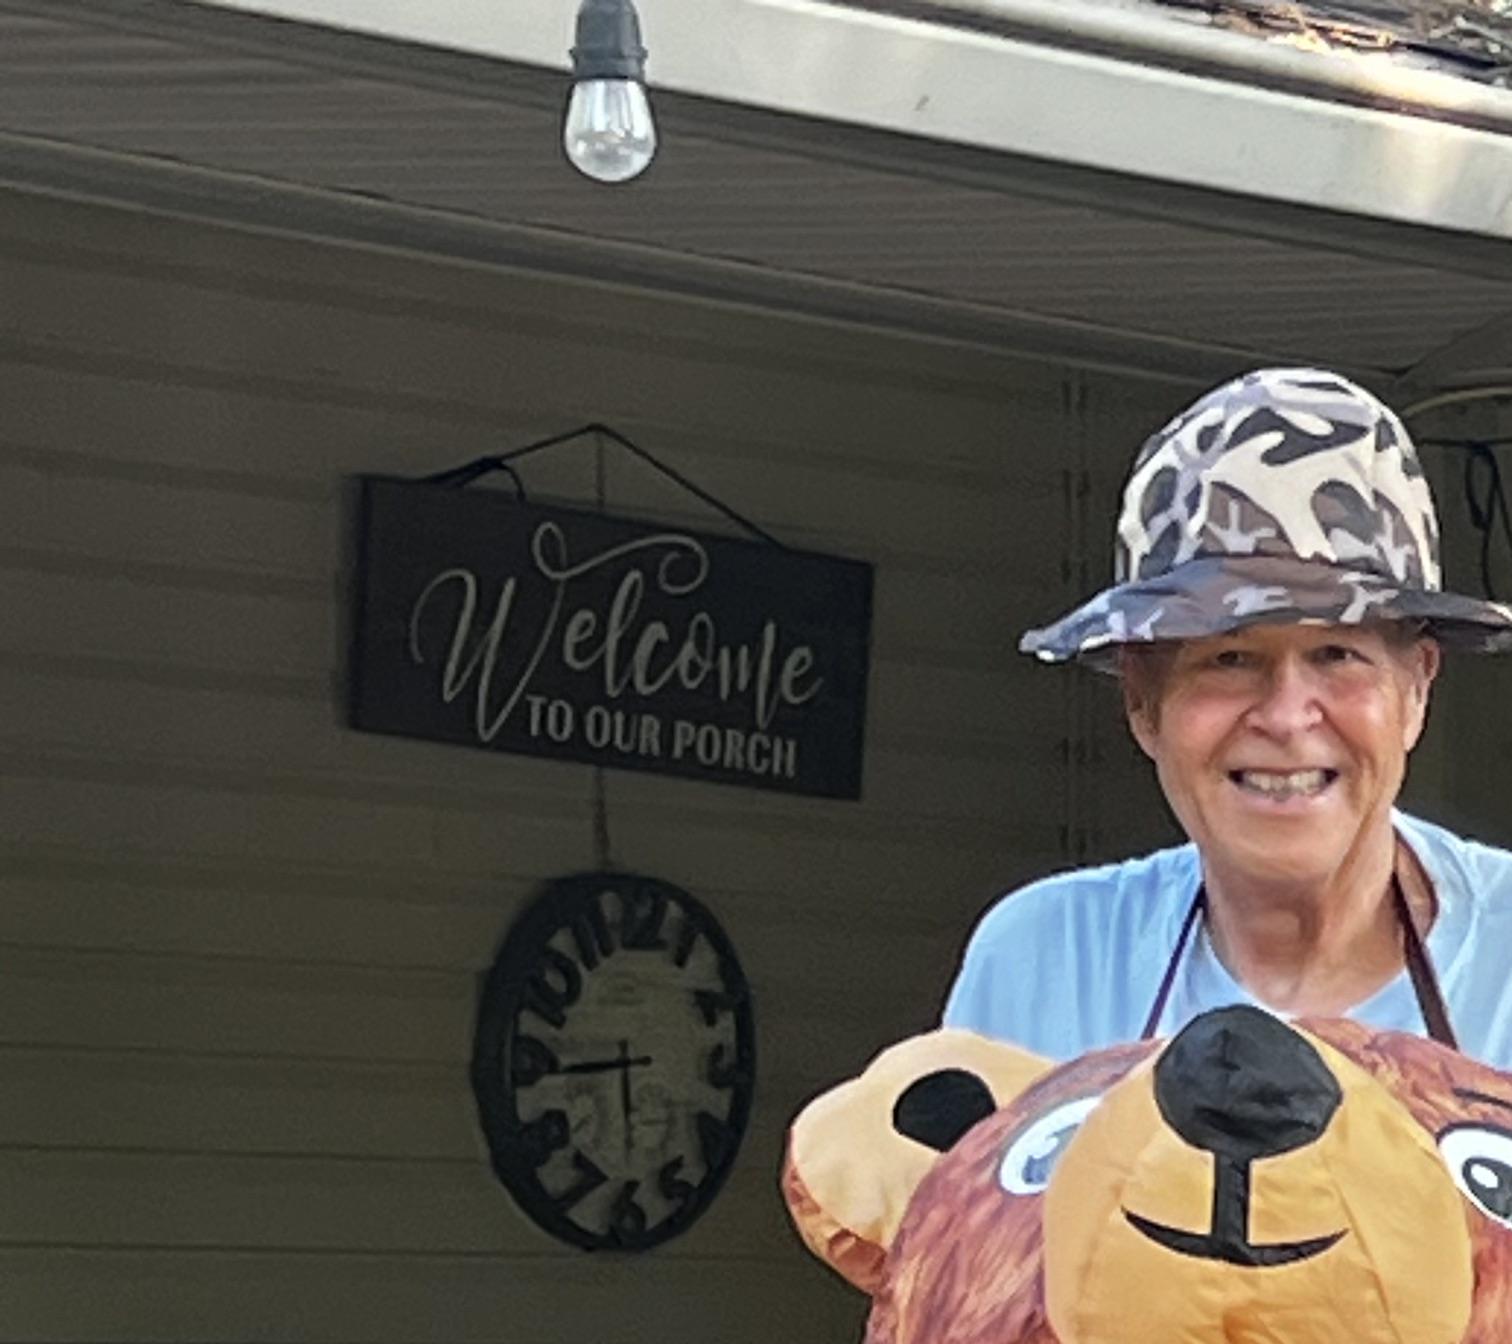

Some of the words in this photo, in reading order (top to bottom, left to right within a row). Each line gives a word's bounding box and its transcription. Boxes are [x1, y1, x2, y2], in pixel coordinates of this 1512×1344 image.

[409, 521, 824, 742] Welcome
[526, 694, 574, 744] TO
[585, 704, 662, 757] OUR
[671, 720, 797, 777] PORCH
